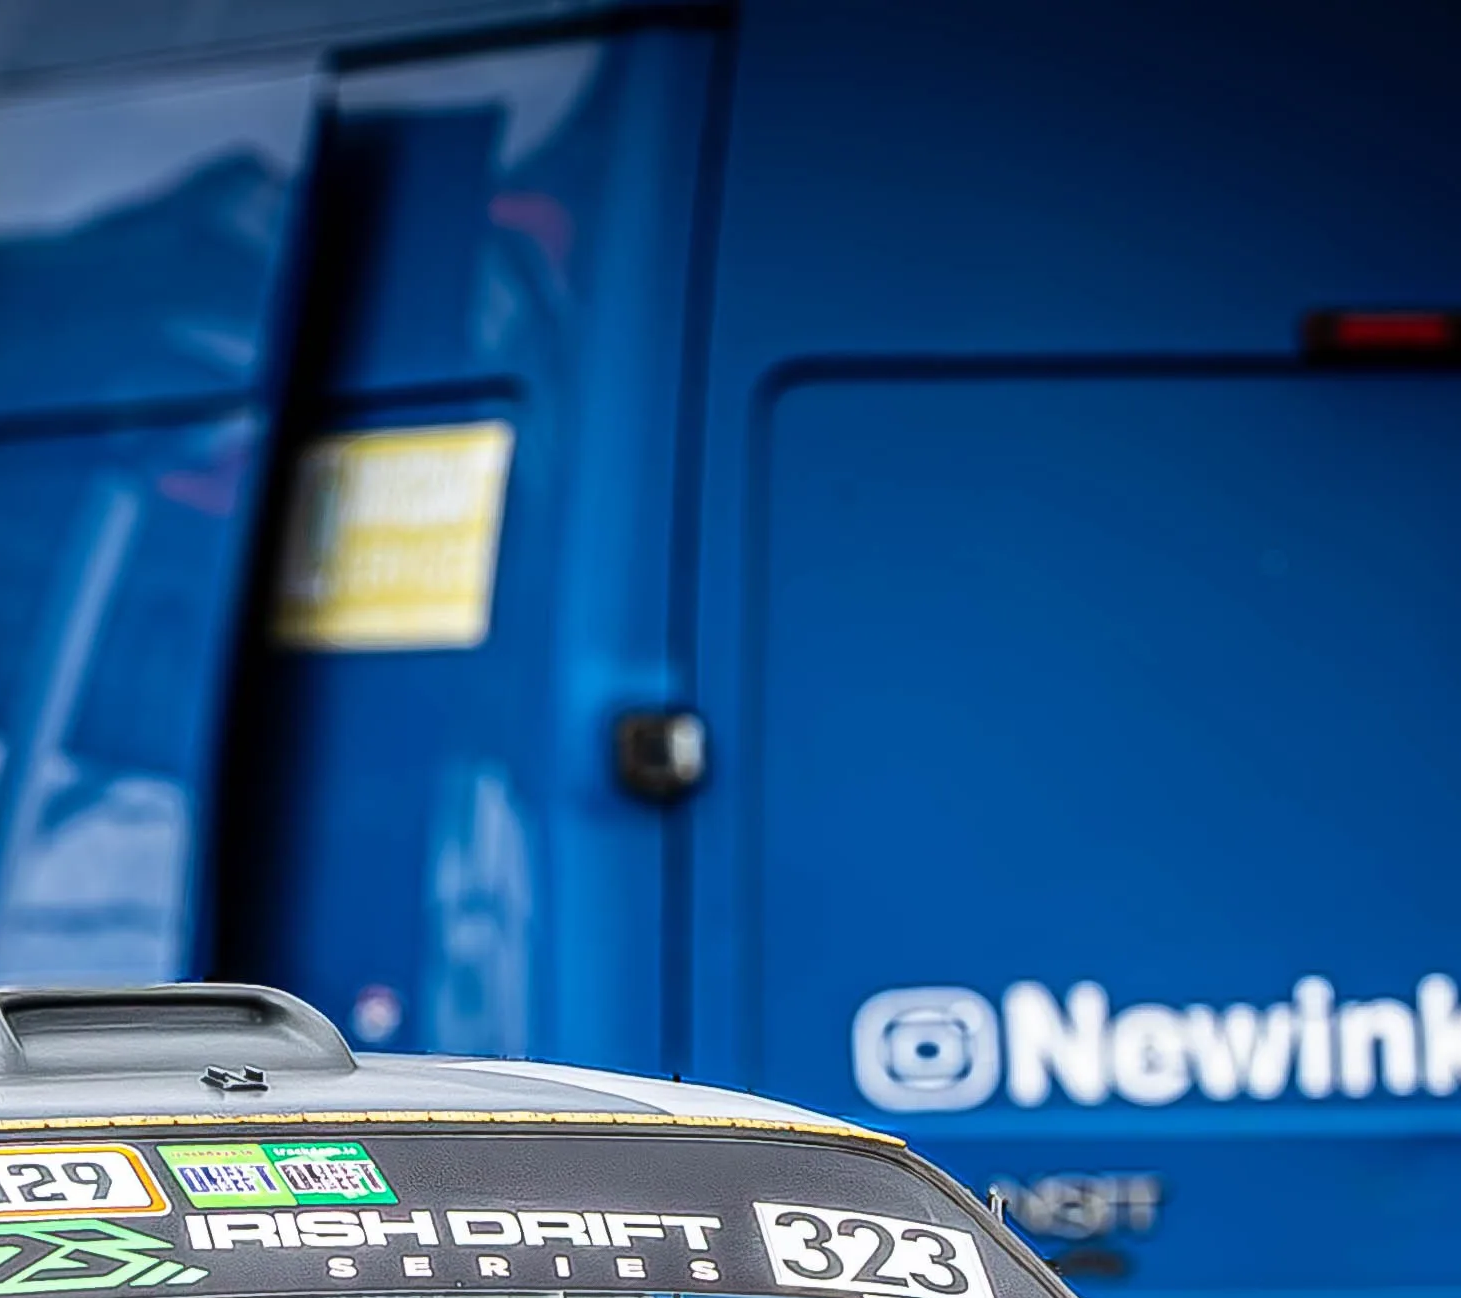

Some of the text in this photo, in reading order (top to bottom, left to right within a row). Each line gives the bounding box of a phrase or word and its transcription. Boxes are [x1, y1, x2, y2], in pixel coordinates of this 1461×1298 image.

[185, 1208, 721, 1252] IRISH DRIFT
[327, 1253, 721, 1283] SERIES
[773, 1210, 970, 1297] 323
